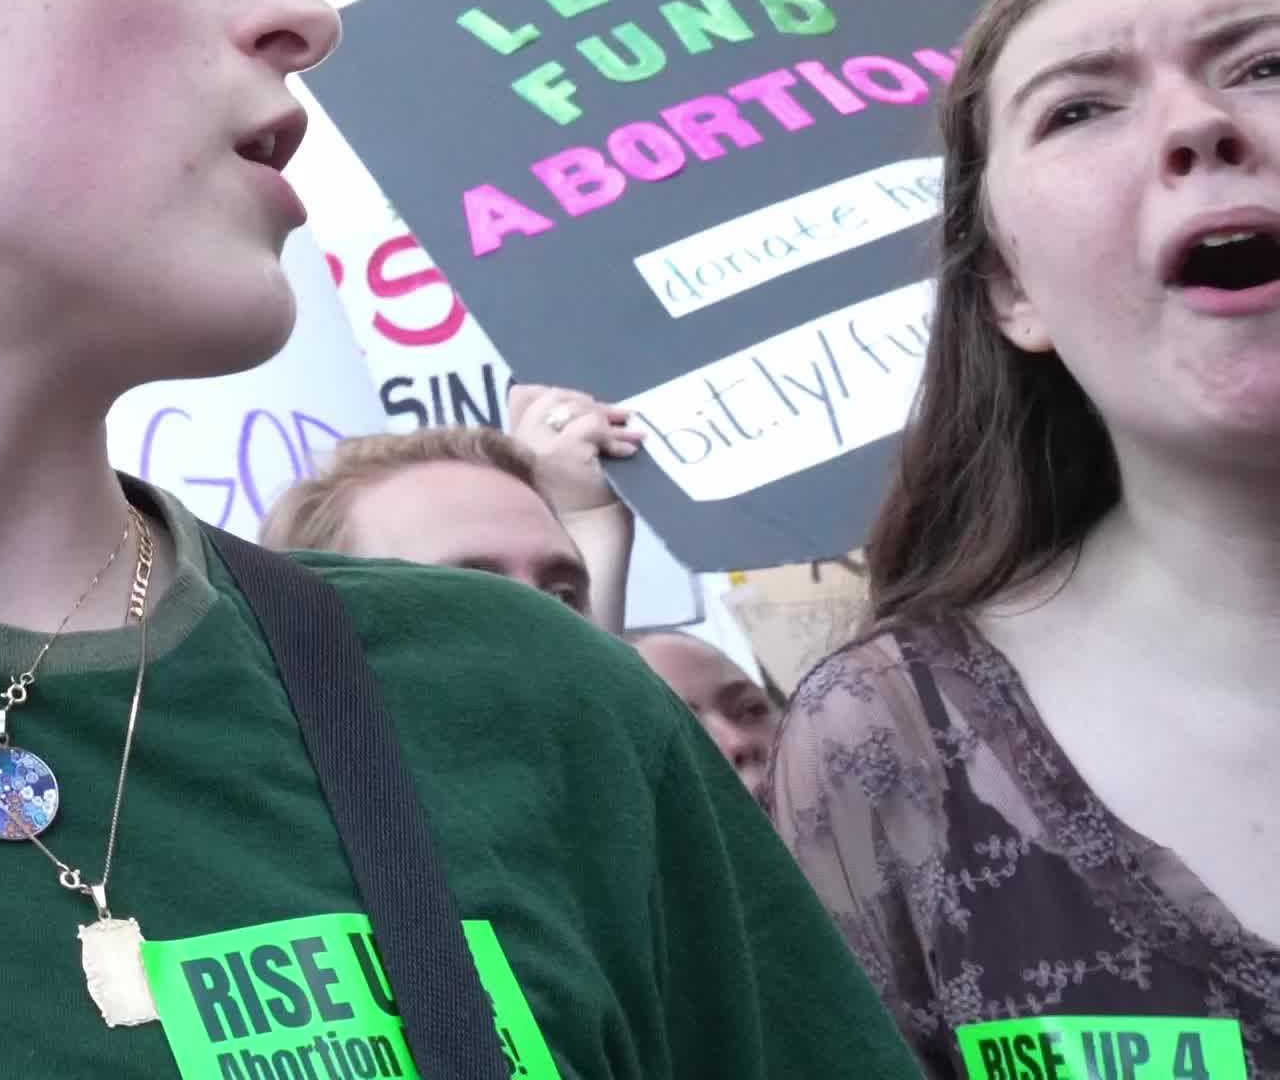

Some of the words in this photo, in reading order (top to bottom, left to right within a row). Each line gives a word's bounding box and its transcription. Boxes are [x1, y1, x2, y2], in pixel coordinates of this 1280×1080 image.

[663, 204, 869, 303] donate
[874, 173, 944, 211] he
[379, 363, 513, 428] SIN
[632, 313, 932, 465] bit.ly/fu
[180, 934, 356, 1044] RISE
[977, 1031, 1067, 1080] RISE
[1080, 1031, 1152, 1080] UP
